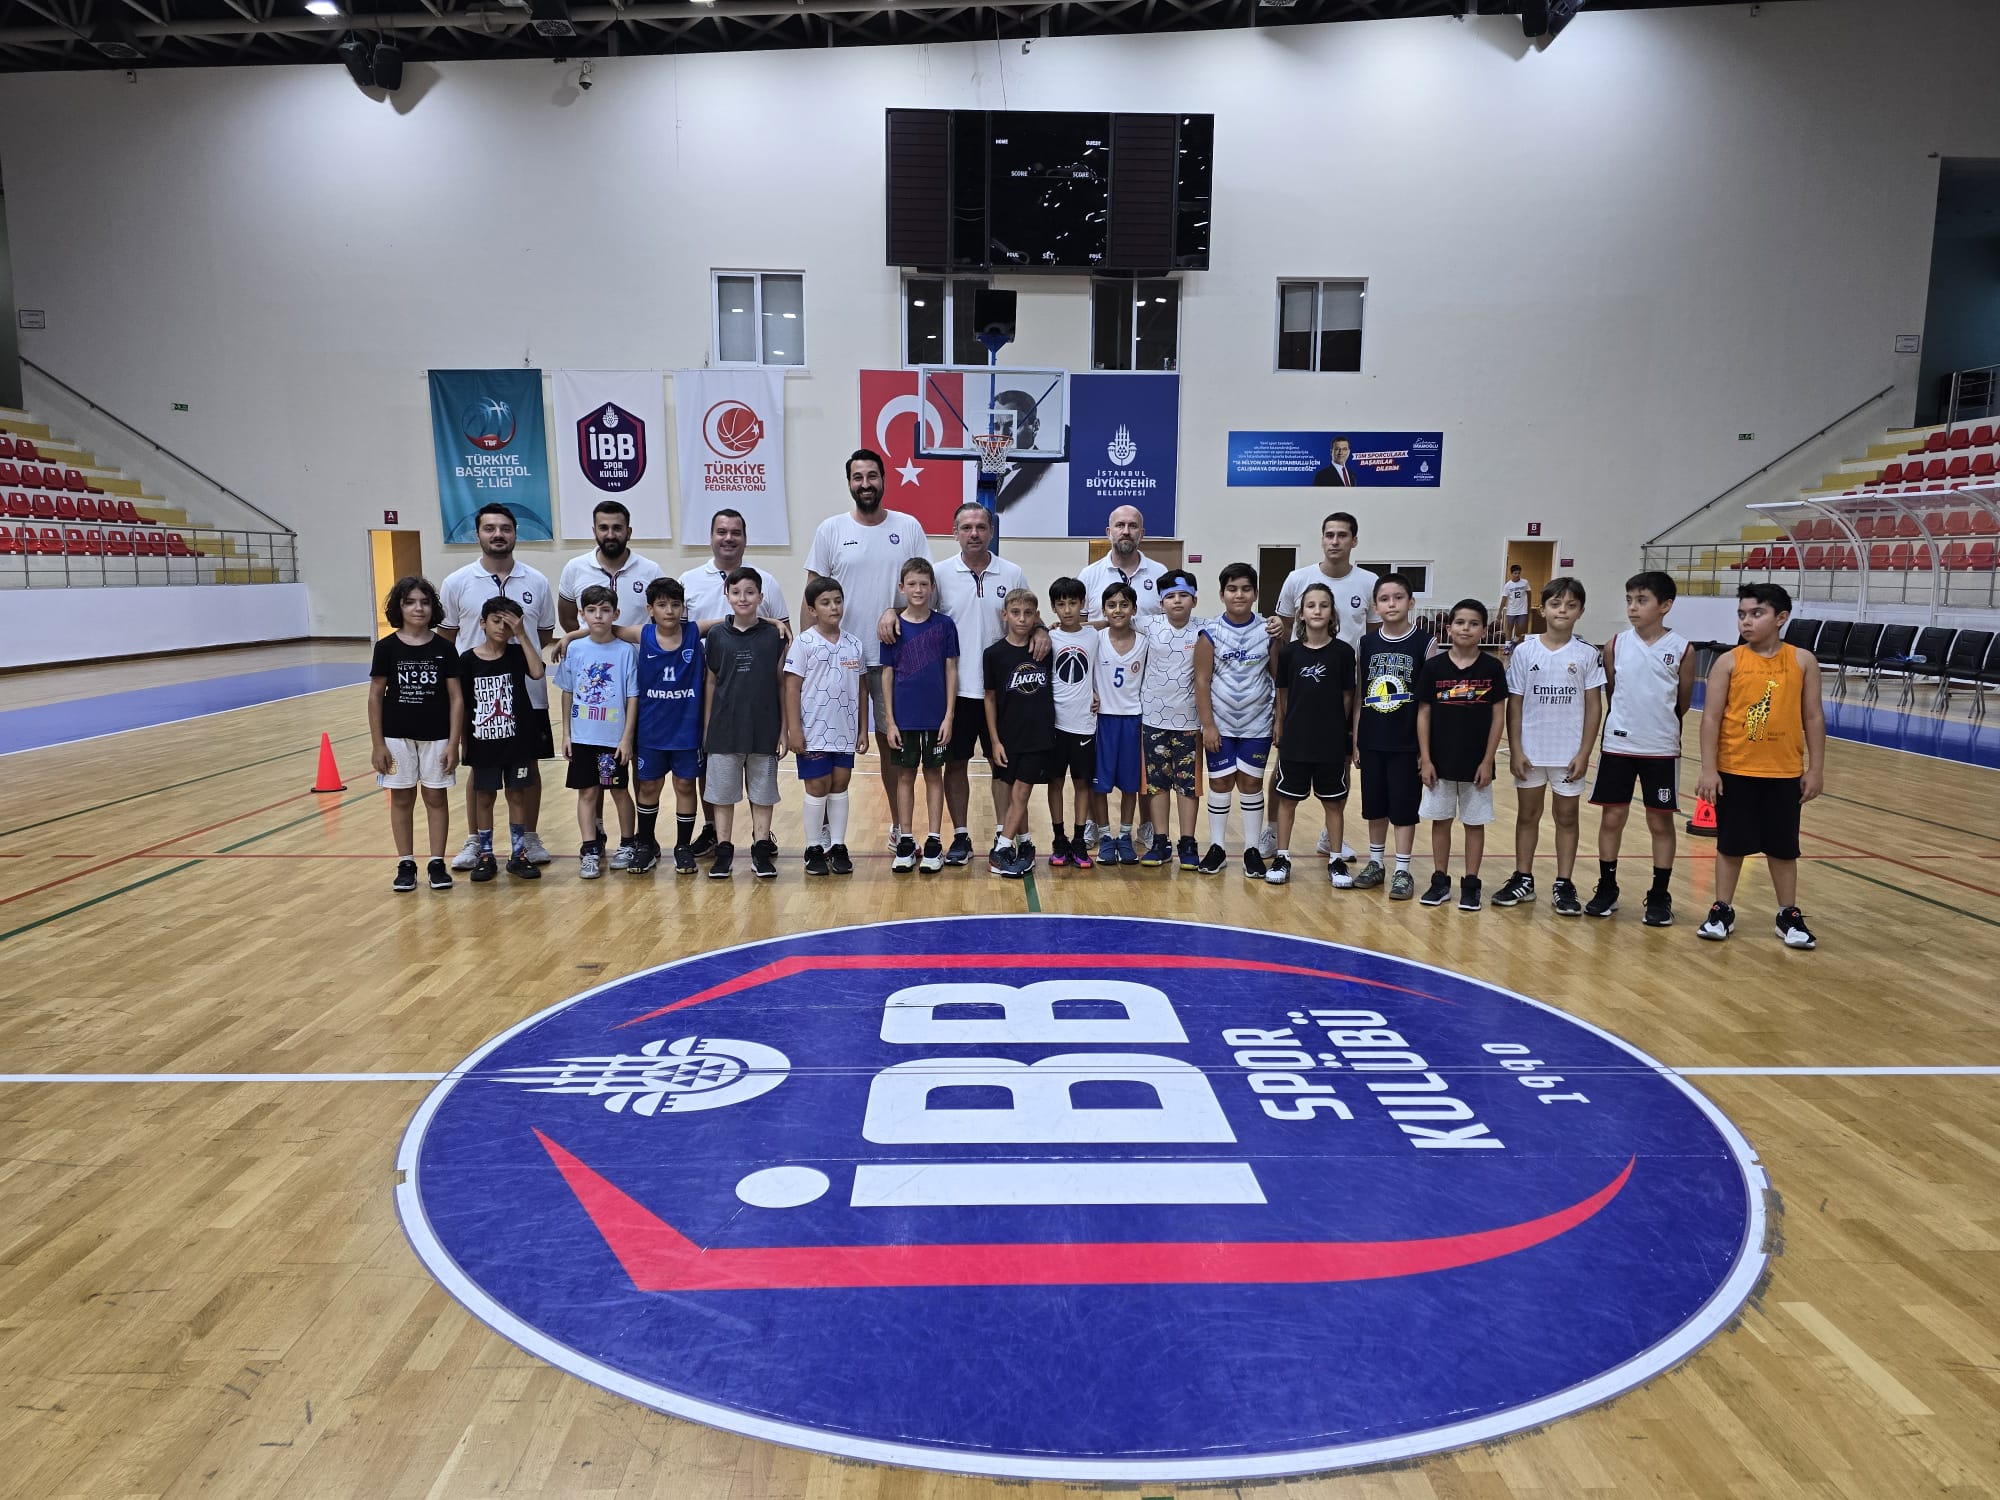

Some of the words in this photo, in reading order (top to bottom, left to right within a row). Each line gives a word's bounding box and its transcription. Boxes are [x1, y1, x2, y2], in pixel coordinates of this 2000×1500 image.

[589, 426, 635, 460] İBB
[465, 454, 519, 466] TÜRKİYE
[455, 466, 532, 477] BASKETBOL
[599, 468, 628, 477] KULÜBÜ
[704, 460, 765, 475] TÜRKİYE
[1097, 469, 1146, 477] İSTANBUL
[704, 476, 766, 484] BASKETBOL
[1086, 477, 1156, 489] BÜYÜKŞEHİR
[388, 511, 394, 519] A
[1514, 591, 1521, 599] 12
[1222, 650, 1247, 661] SPOR
[1369, 653, 1413, 670] FENER
[663, 666, 676, 682] 11
[1113, 667, 1124, 688] 5
[476, 674, 512, 690] JORDAN
[1009, 672, 1047, 689] LAKERS
[647, 688, 695, 699] AVRASYA
[1533, 684, 1577, 695] Emirates
[1539, 696, 1548, 704] FLY
[1550, 696, 1572, 704] BETTER
[572, 704, 619, 722] SONIC
[479, 726, 516, 739] JORDAN
[1221, 1028, 1355, 1120] SPOR
[1286, 1009, 1506, 1149] KULÜBÜ
[1481, 1043, 1591, 1104] 1990
